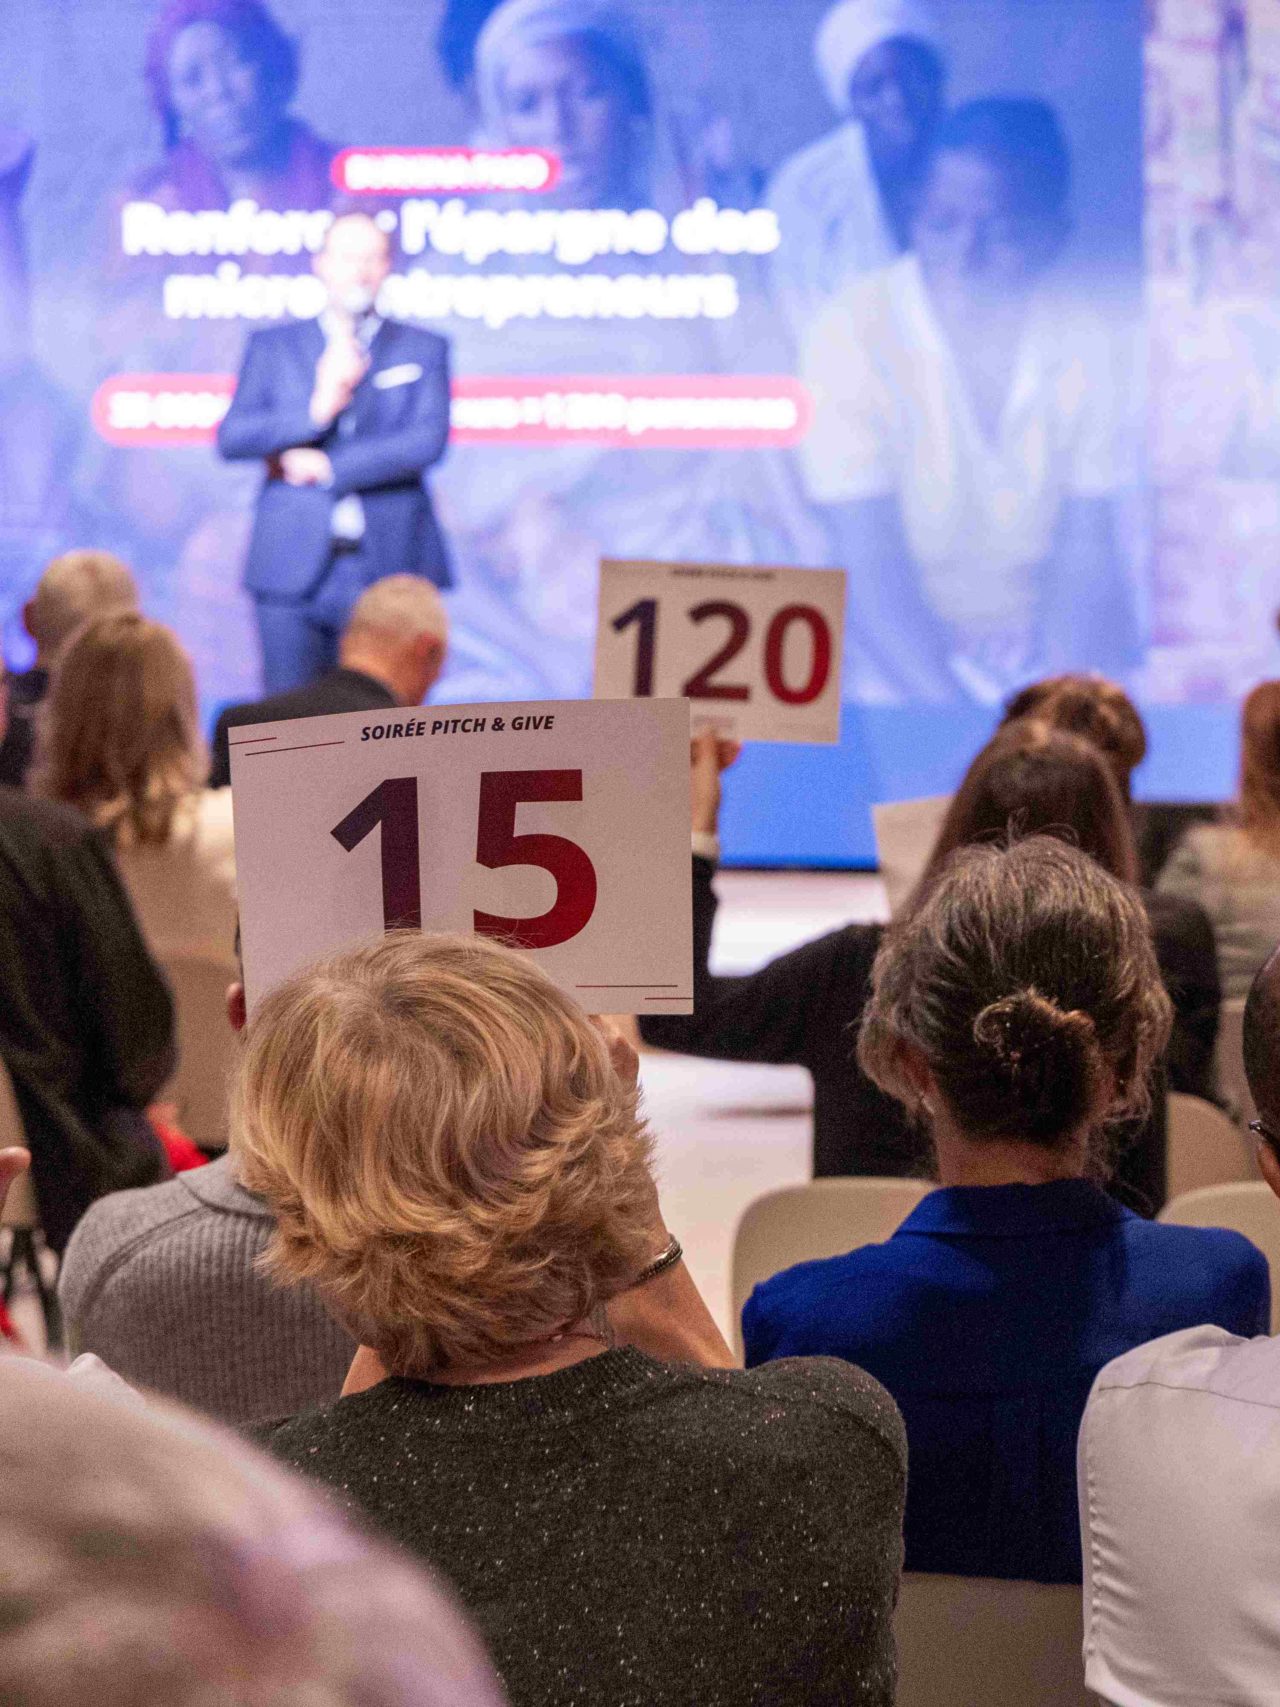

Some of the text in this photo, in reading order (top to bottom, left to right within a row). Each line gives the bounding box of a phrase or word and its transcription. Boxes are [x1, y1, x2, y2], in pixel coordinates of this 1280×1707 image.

[672, 197, 780, 254] des
[611, 598, 832, 706] 120
[361, 715, 555, 741] SOIRÉE PITCH & GIVE
[330, 769, 597, 950] 15
